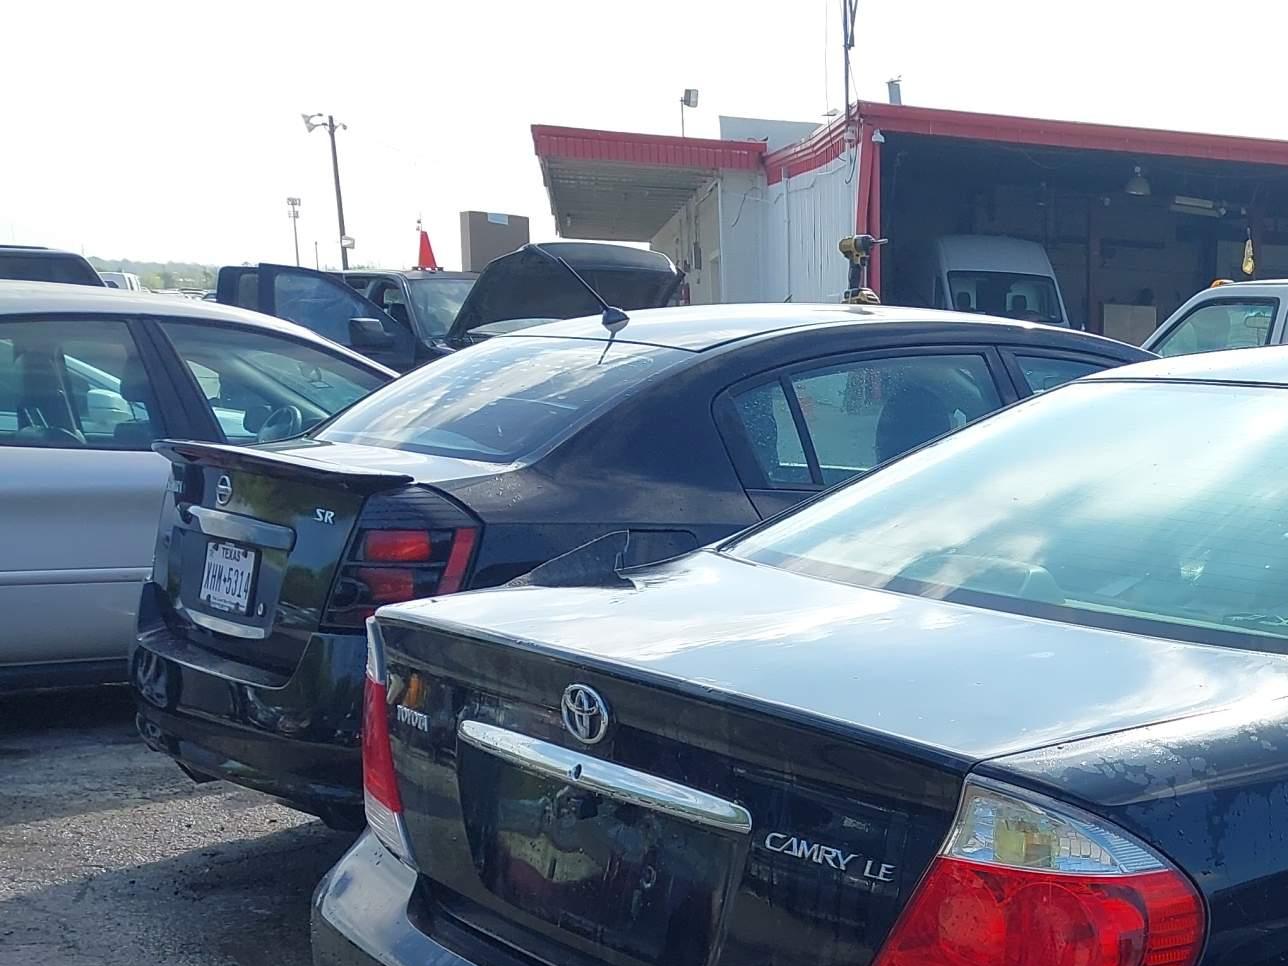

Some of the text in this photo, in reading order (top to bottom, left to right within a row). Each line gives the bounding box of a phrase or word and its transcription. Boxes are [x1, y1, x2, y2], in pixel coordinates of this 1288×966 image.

[312, 508, 335, 525] SR
[222, 547, 241, 562] TEXAS
[397, 705, 428, 732] TOYOTA
[765, 832, 897, 882] CAMRY LE
